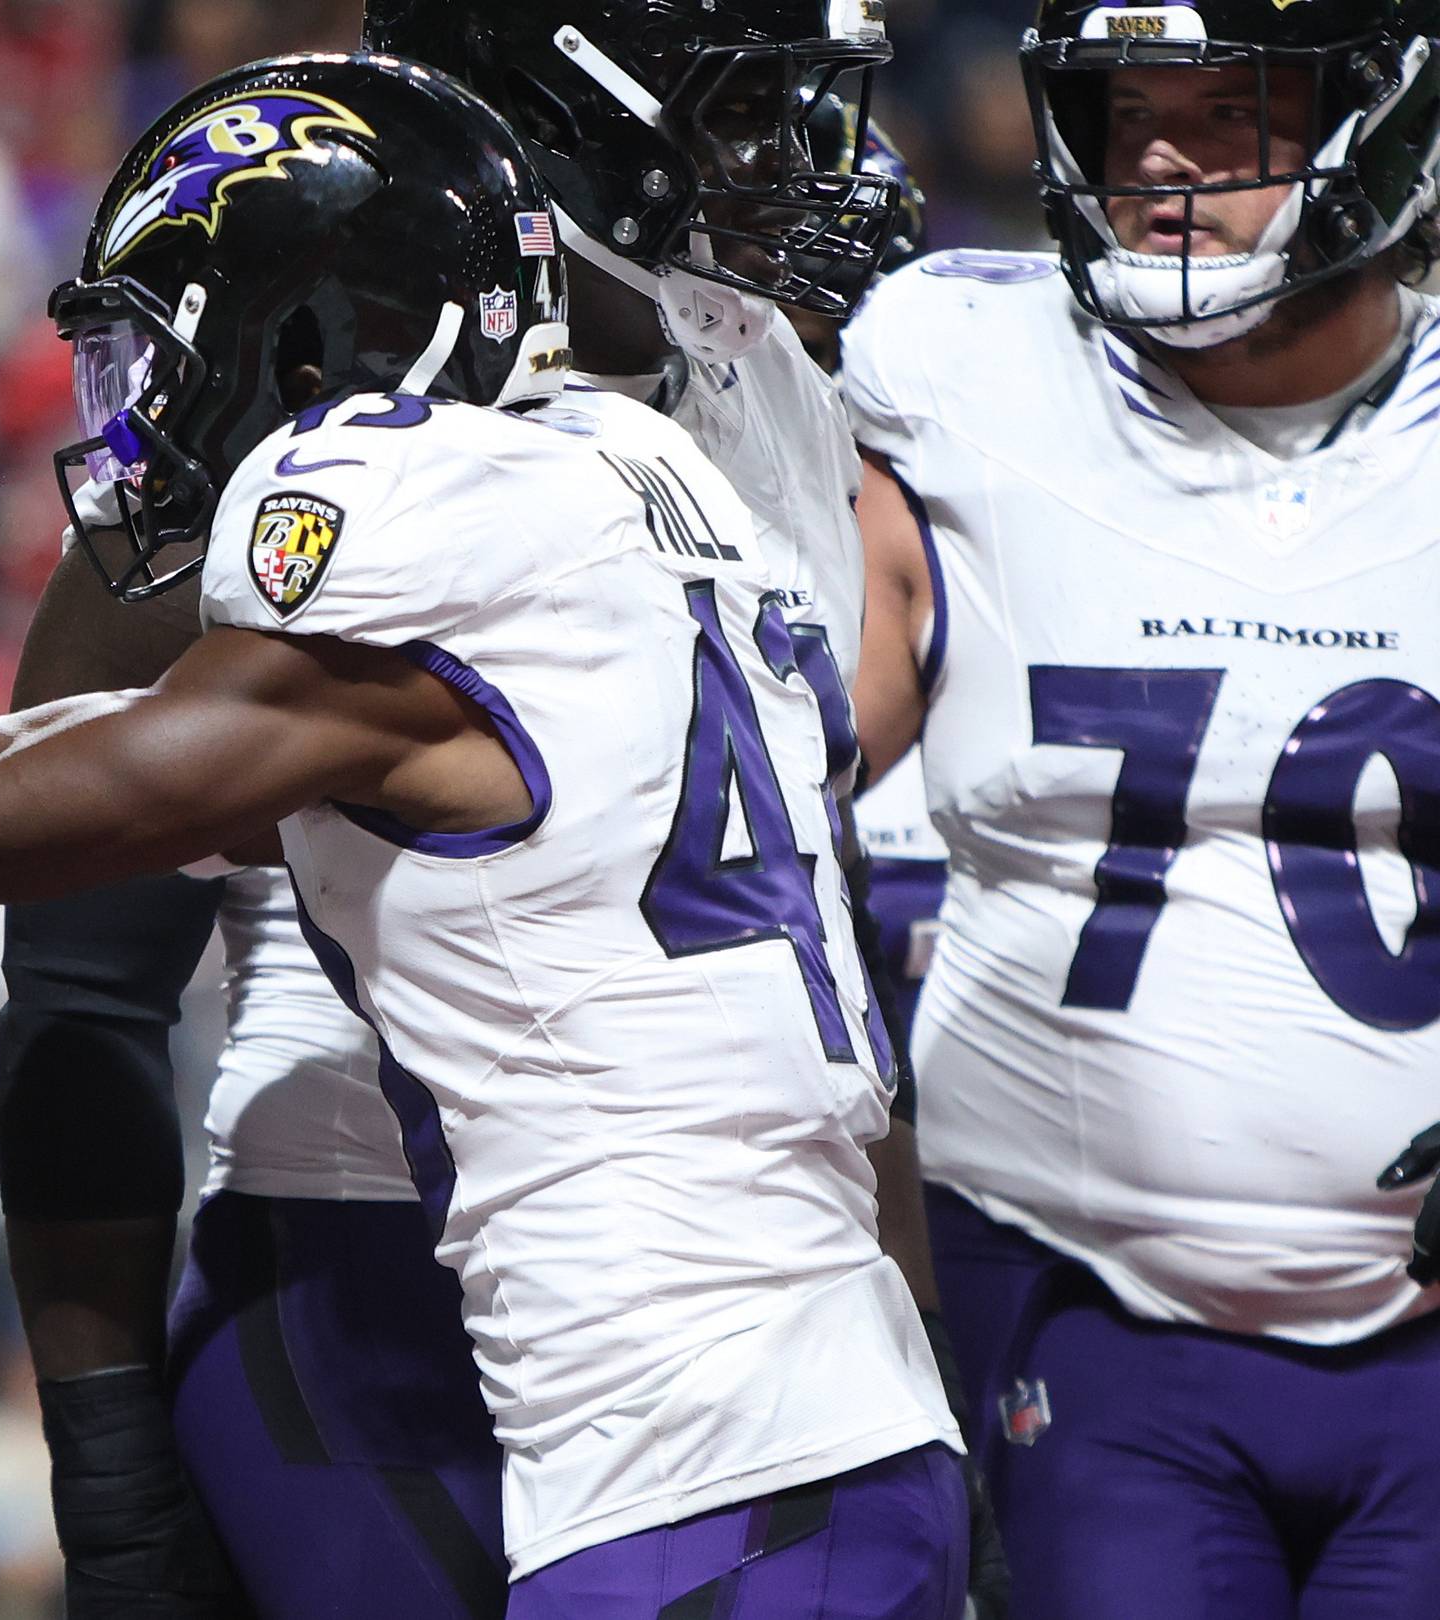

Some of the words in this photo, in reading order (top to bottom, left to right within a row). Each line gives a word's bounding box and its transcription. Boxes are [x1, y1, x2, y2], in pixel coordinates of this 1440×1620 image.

[1105, 15, 1168, 35] RAVENS
[170, 104, 279, 157] B
[486, 313, 513, 332] NFL
[264, 497, 338, 522] RAVENS
[597, 450, 743, 561] HILL
[258, 514, 295, 549] B
[282, 555, 317, 592] R
[1140, 617, 1400, 650] BALTIMORE
[1028, 664, 1440, 1033] 70
